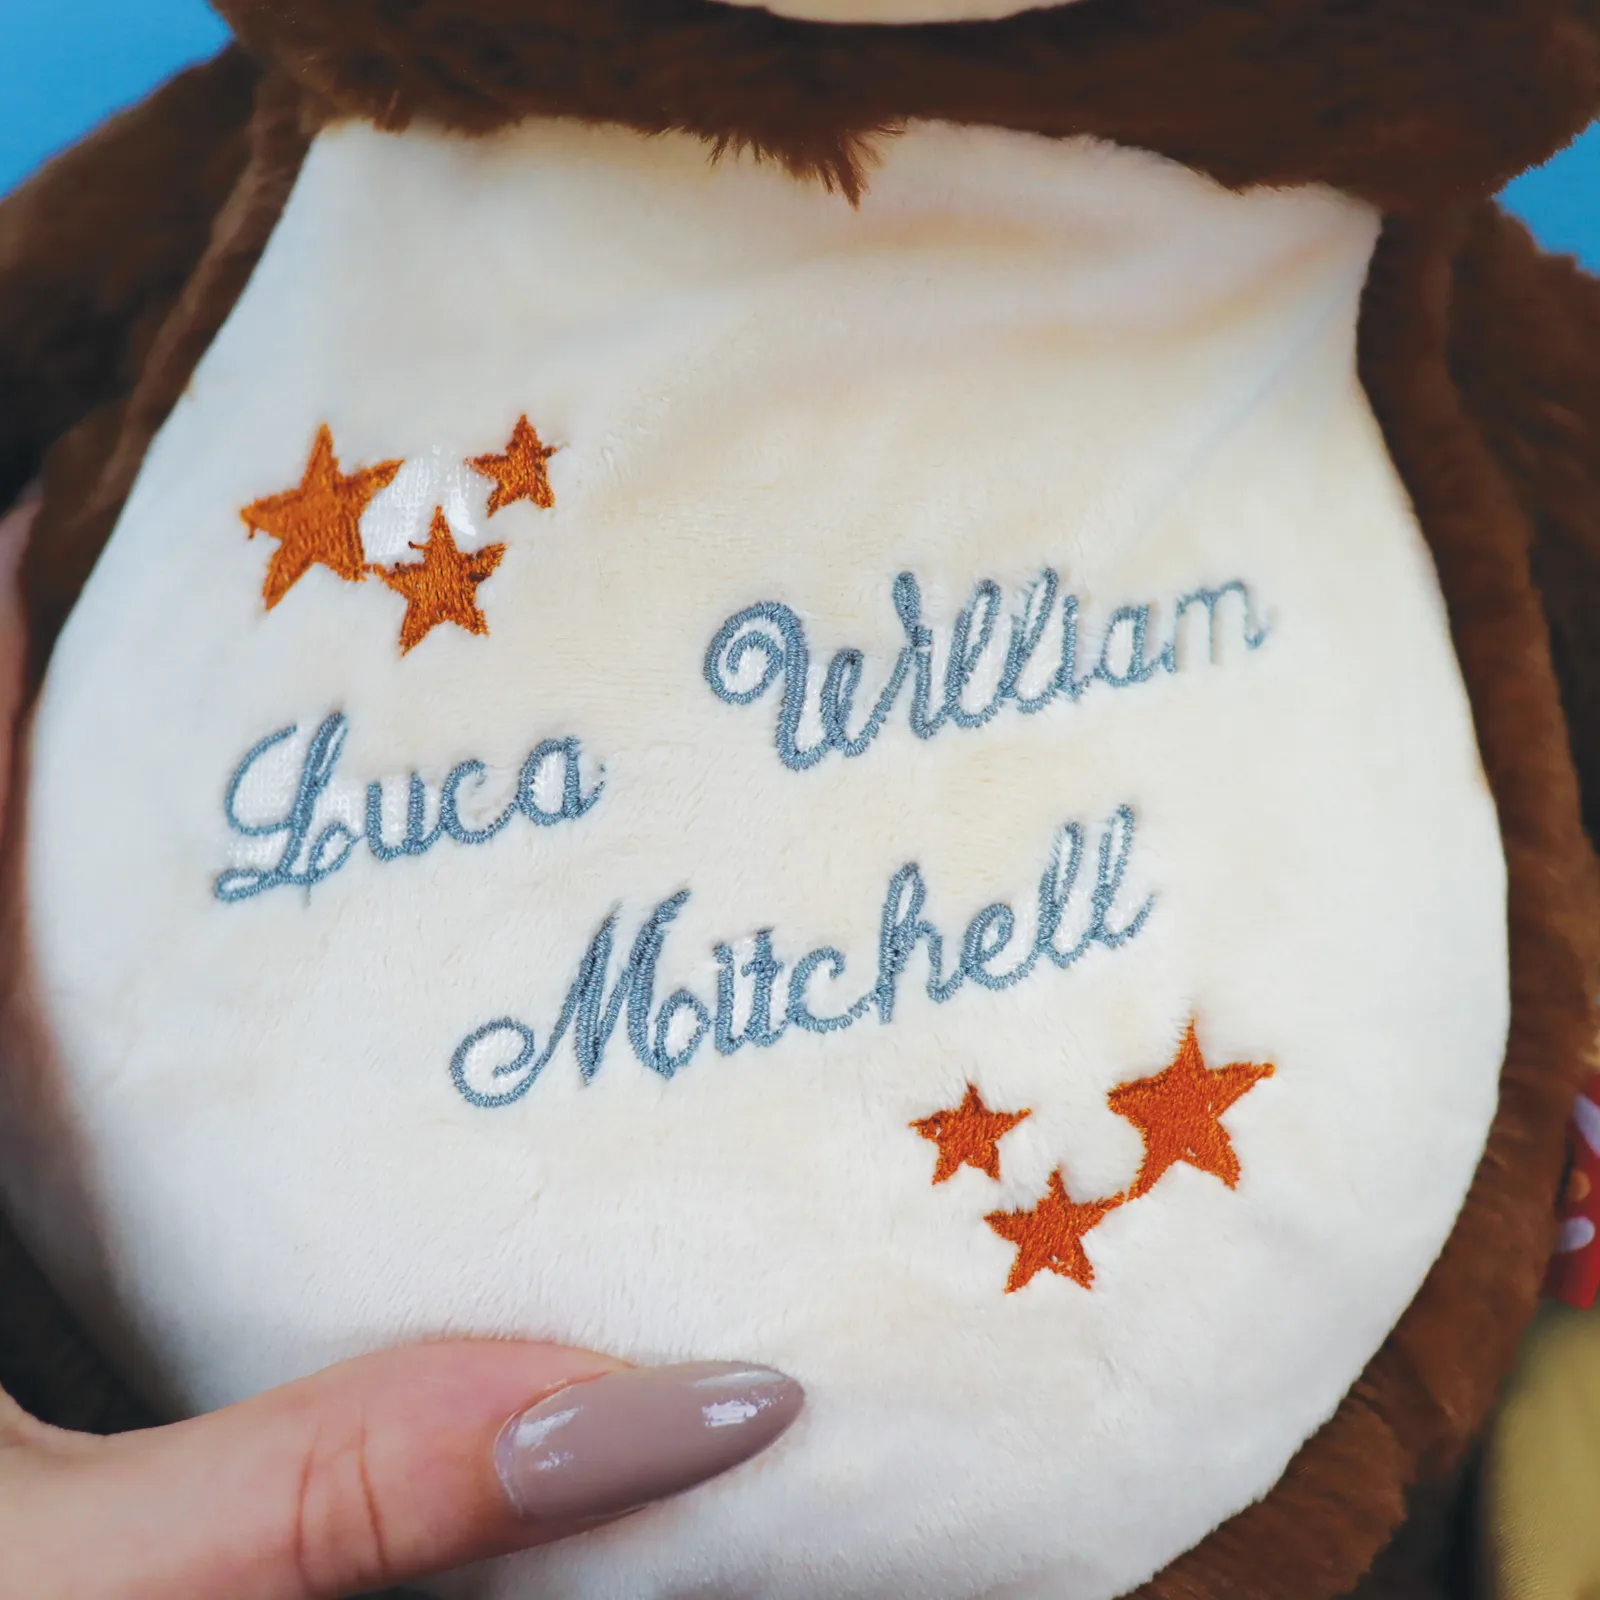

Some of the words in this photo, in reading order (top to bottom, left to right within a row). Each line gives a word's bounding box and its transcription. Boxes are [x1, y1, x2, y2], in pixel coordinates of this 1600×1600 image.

[212, 711, 606, 902] Luca
[703, 568, 1271, 770] William
[449, 804, 1156, 1106] Mitchell
